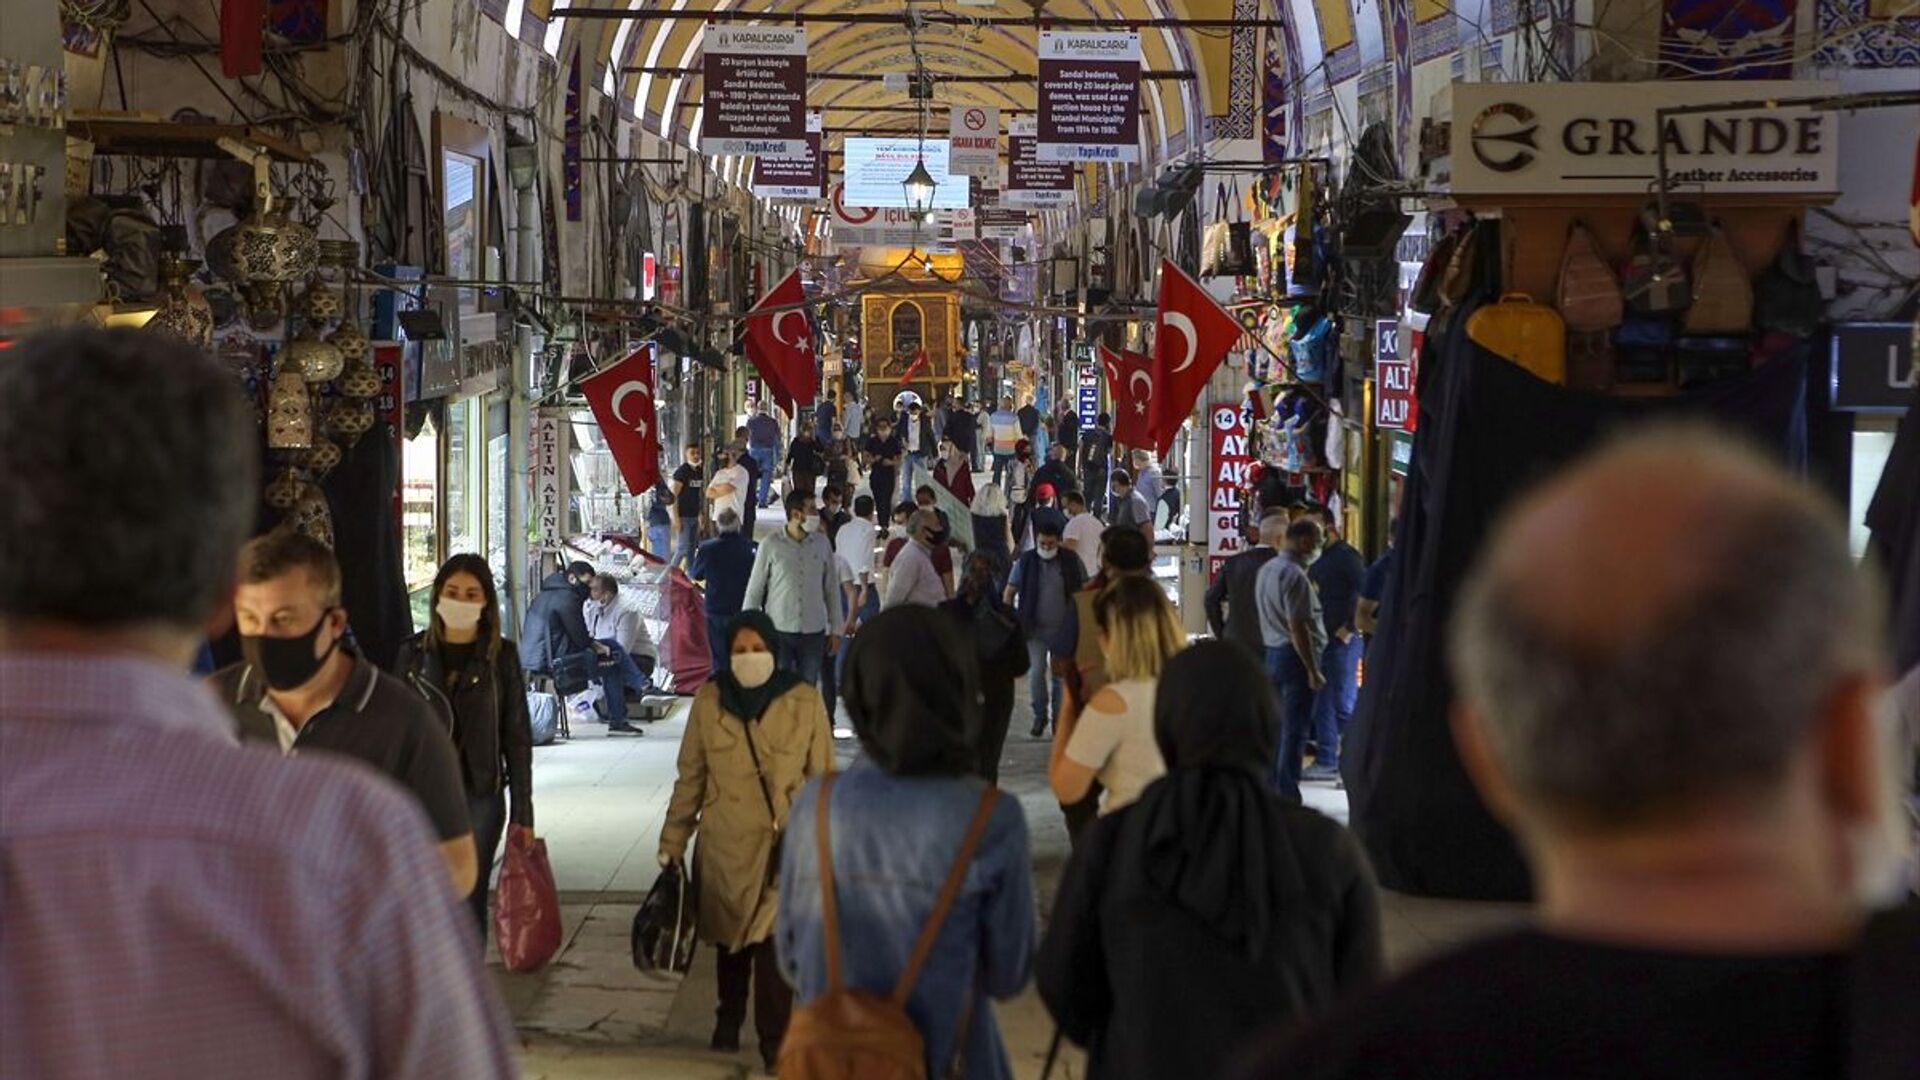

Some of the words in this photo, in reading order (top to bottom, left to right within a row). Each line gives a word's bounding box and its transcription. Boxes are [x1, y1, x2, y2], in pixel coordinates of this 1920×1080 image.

[720, 58, 730, 66] 20
[758, 70, 775, 78] olan
[1059, 70, 1085, 79] Sandal
[723, 80, 749, 89] Sandal
[1044, 81, 1073, 89] covered
[1073, 81, 1083, 91] by
[1083, 82, 1093, 90] 20
[1049, 92, 1075, 101] domes,
[1091, 93, 1108, 101] used
[720, 102, 752, 113] Belediye
[1052, 103, 1080, 112] auction
[1080, 103, 1102, 112] house
[1102, 104, 1112, 114] by
[1112, 104, 1125, 112] the
[767, 115, 791, 123] olarak
[1081, 115, 1126, 125] Municipality
[1057, 125, 1075, 134] from
[1091, 125, 1099, 134] to
[1562, 116, 1823, 156] GRANDE
[1727, 167, 1819, 182] Accessories
[1384, 366, 1410, 390] ALT
[1216, 413, 1233, 424] 14
[542, 420, 555, 476] ALTIN
[1212, 487, 1241, 508] AL
[542, 482, 557, 548] ALINIR
[1217, 513, 1239, 530] GÜ
[1218, 537, 1239, 551] AL
